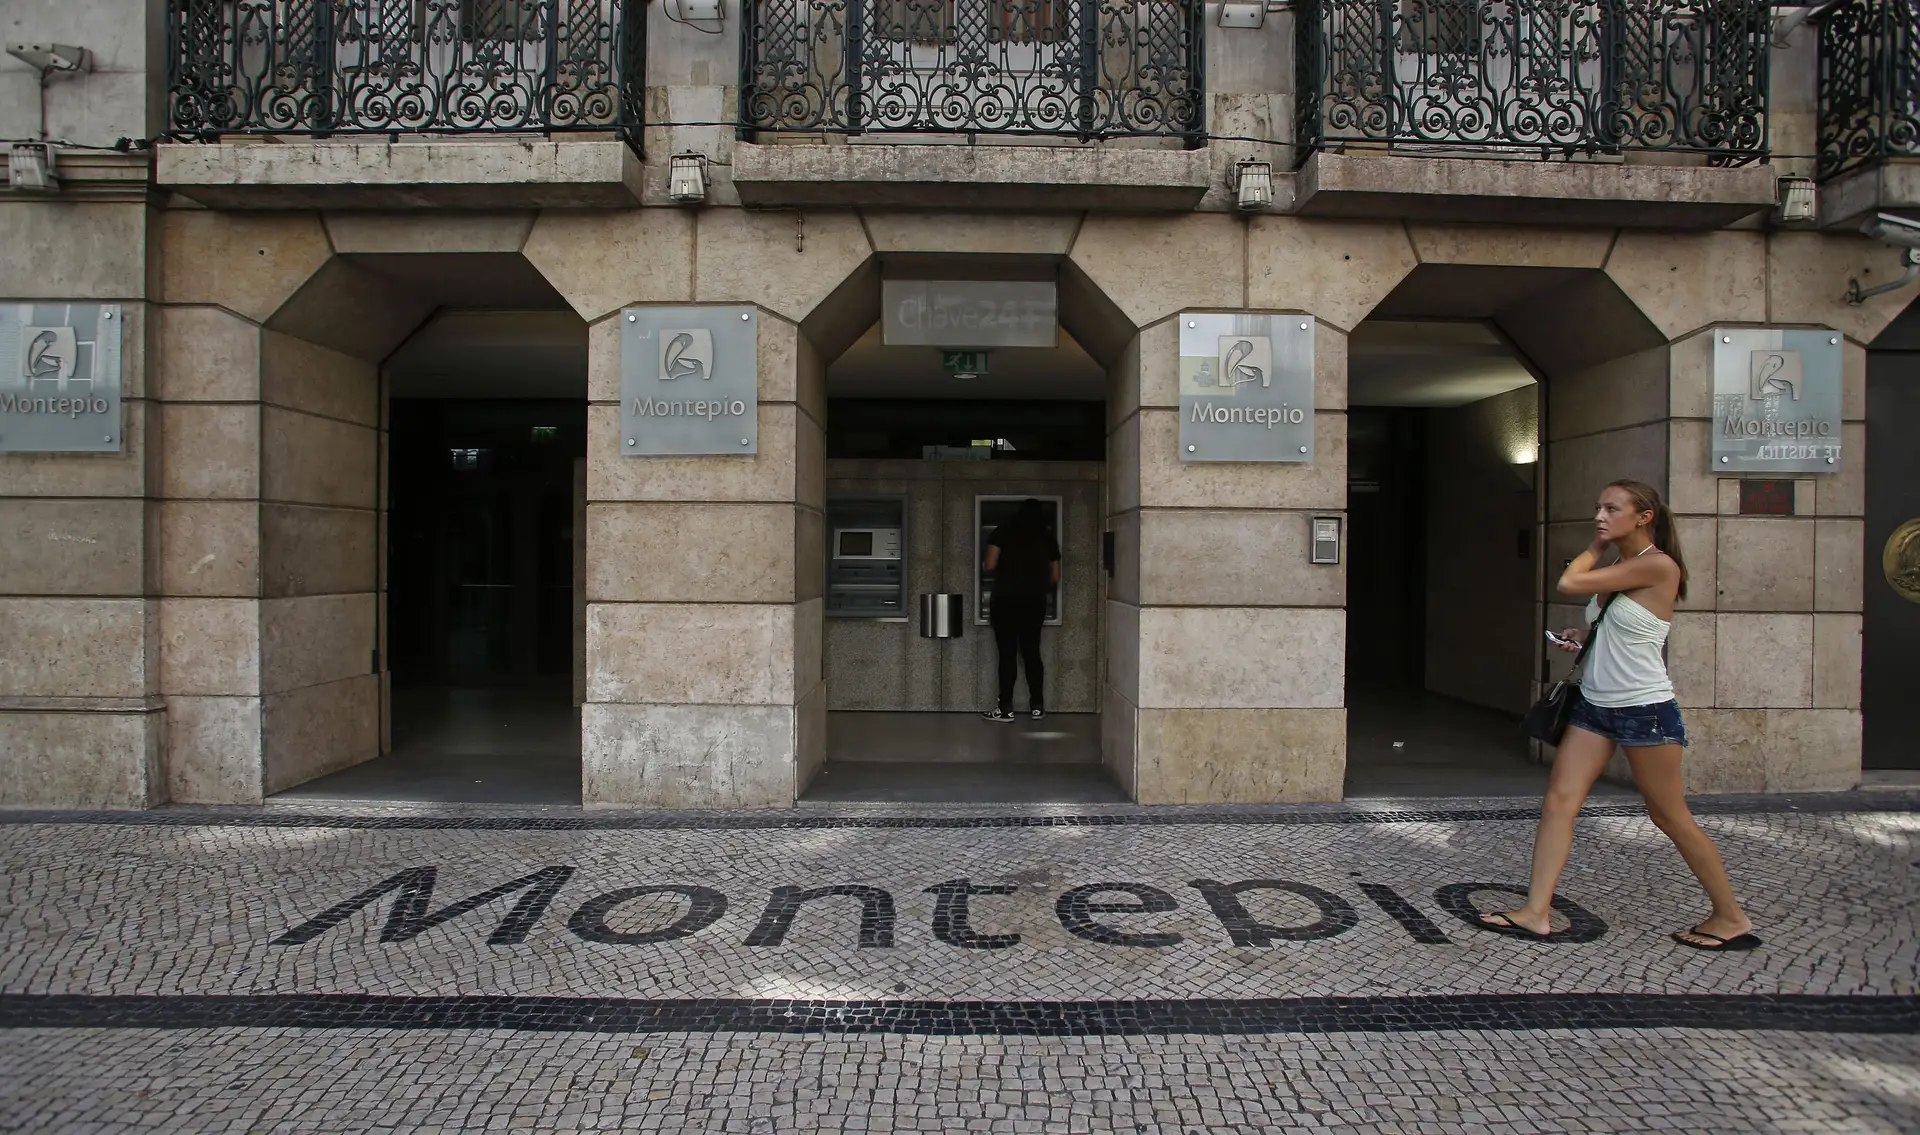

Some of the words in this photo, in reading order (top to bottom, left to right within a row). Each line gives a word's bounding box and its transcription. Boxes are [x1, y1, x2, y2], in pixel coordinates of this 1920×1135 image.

[0, 393, 109, 420] Montepio
[632, 394, 746, 422] Montepio
[1191, 402, 1305, 430] Montepio
[1724, 415, 1829, 440] Montepio
[270, 865, 1607, 948] Montepio
